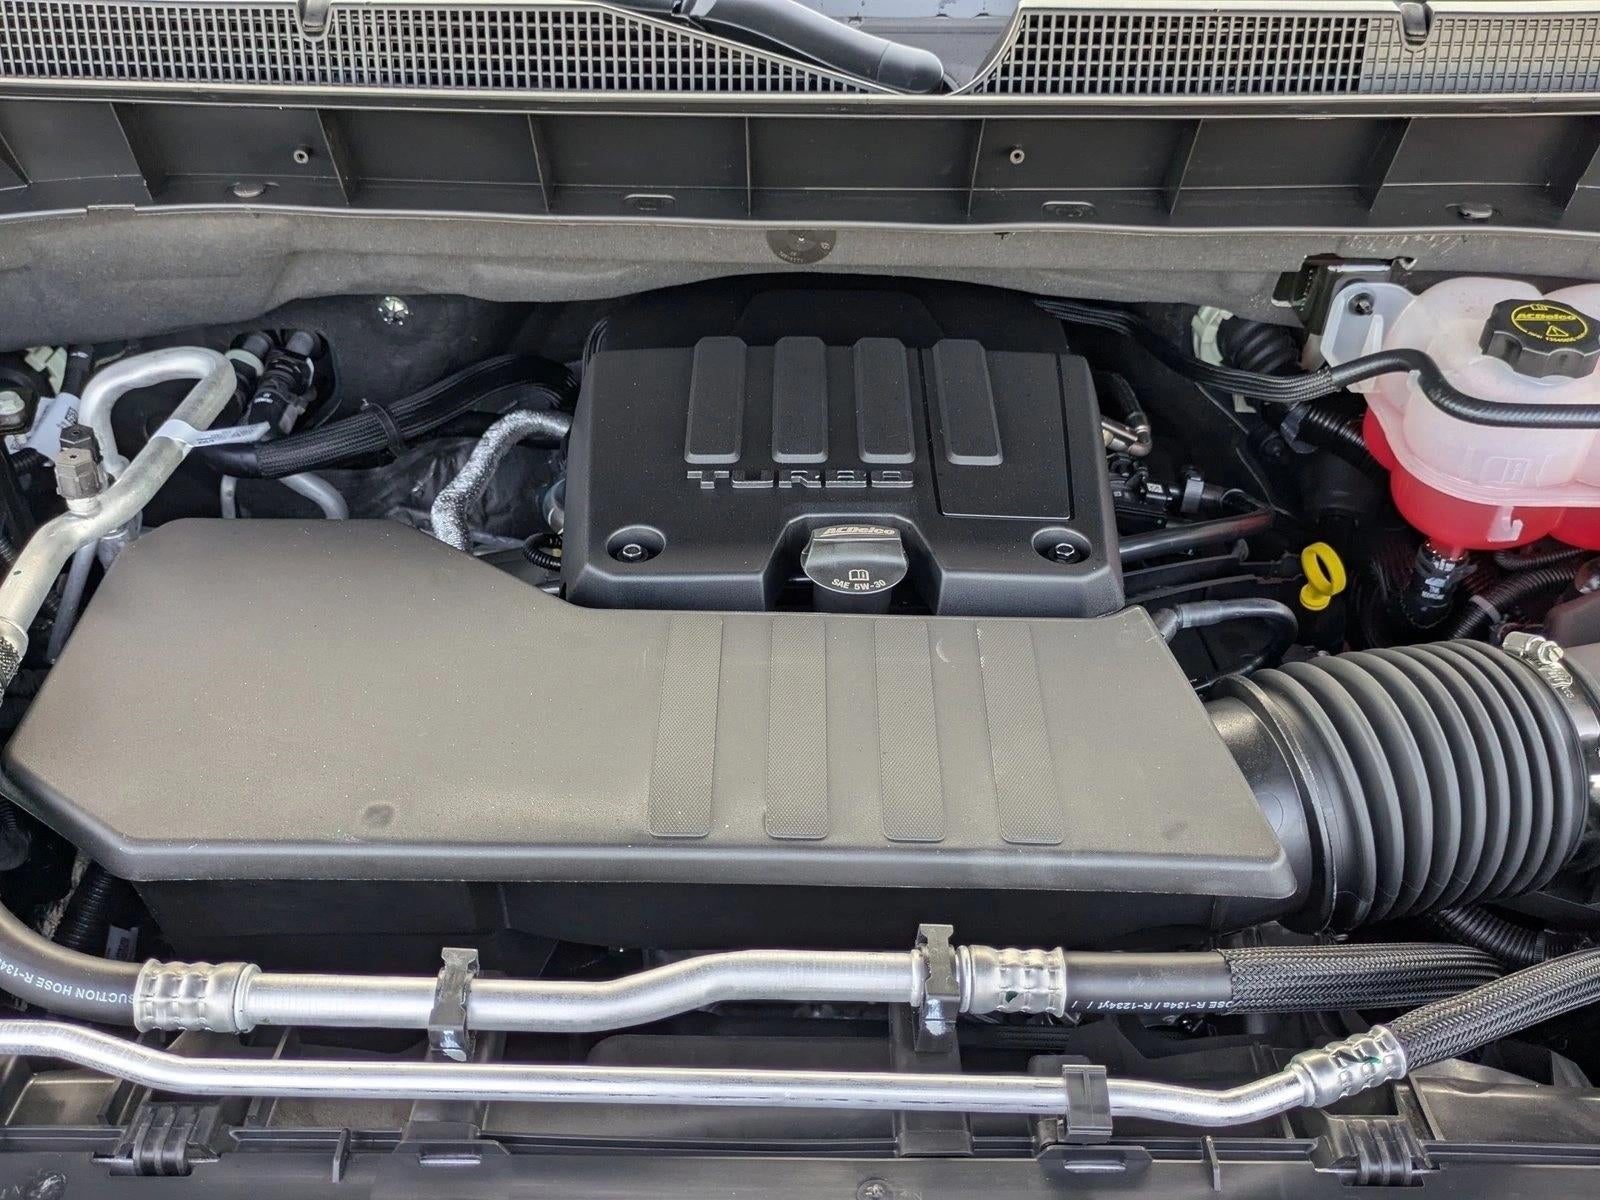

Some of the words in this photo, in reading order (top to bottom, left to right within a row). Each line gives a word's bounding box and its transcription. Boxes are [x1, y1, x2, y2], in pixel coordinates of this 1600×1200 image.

[1514, 313, 1577, 322] ACDelco
[687, 470, 914, 489] TURBO
[820, 526, 895, 537] ACDelco
[831, 578, 850, 589] SAE
[854, 579, 886, 590] 5W-30
[0, 958, 34, 984] R-134
[35, 976, 73, 996] HOSE
[1097, 1000, 1153, 1010] R-1234yf
[1163, 1001, 1206, 1009] R-134a
